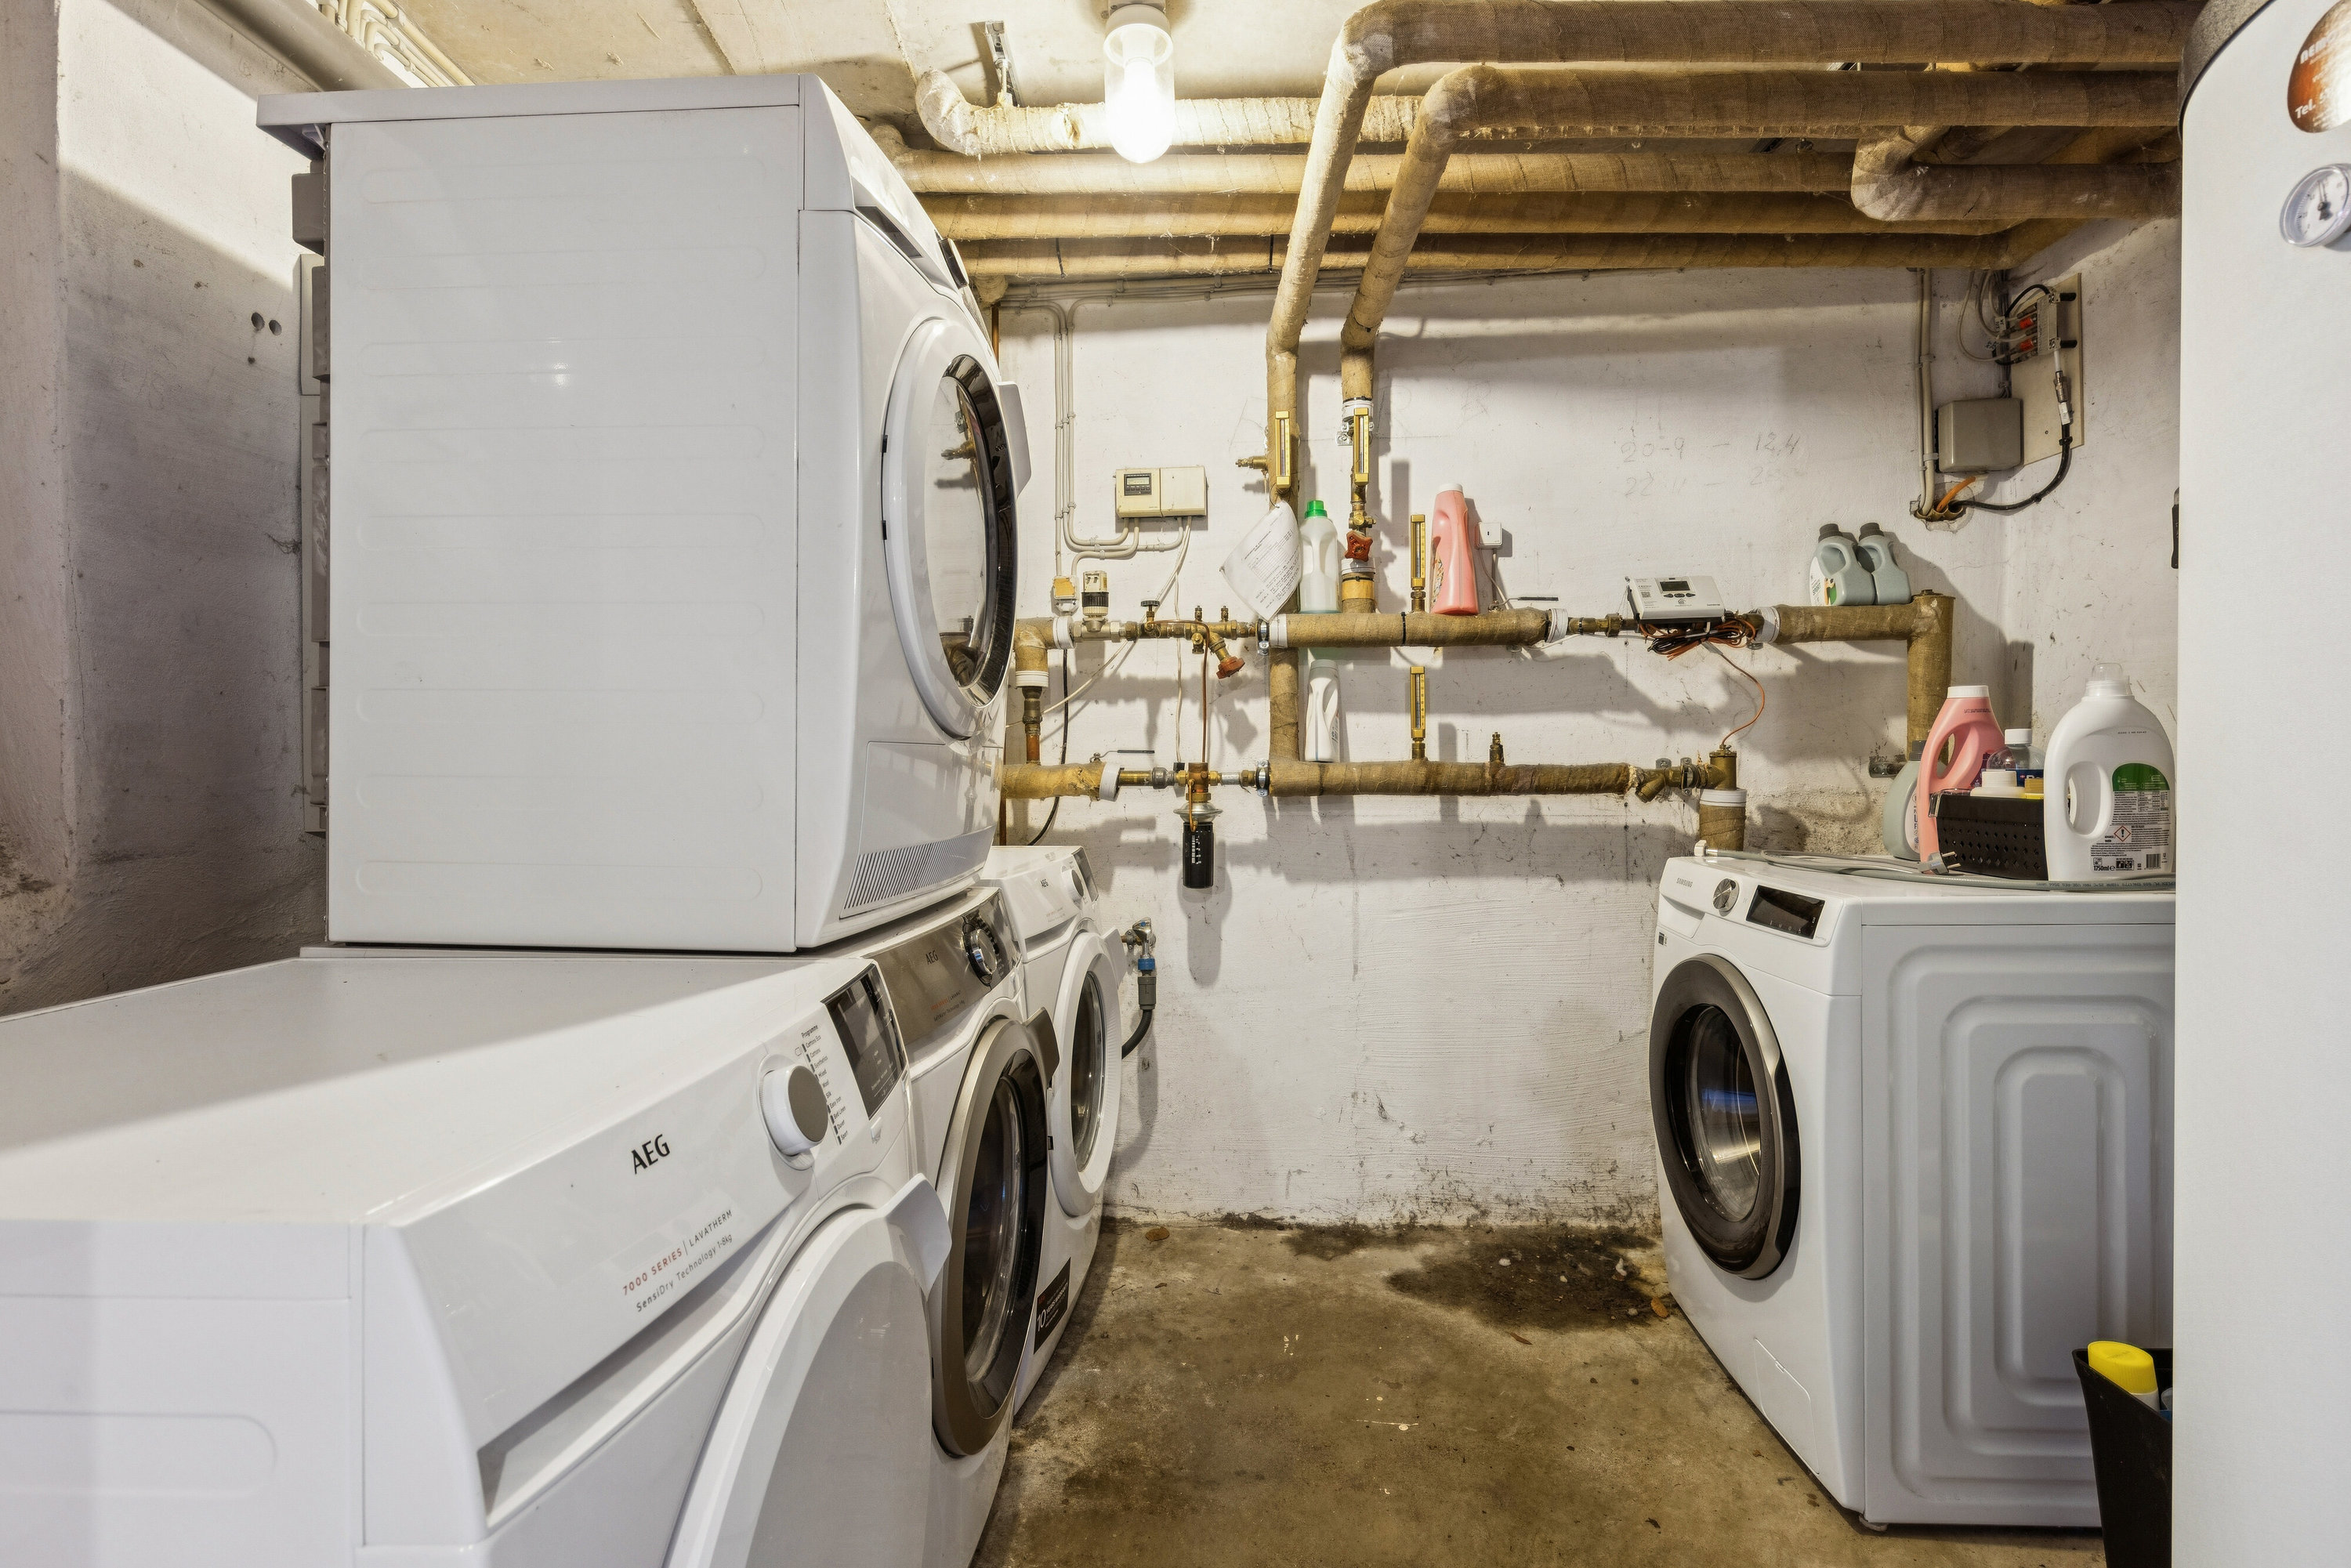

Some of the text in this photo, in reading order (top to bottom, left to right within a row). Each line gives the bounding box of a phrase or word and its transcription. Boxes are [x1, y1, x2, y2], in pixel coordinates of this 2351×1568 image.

[1040, 878, 1049, 888] AEG
[1676, 877, 1694, 888] SAMSUNG
[926, 950, 939, 965] AEG
[801, 1024, 819, 1038] Programme
[806, 1038, 816, 1048] Cottons
[813, 1056, 828, 1068] Synthetics
[818, 1069, 828, 1078] Mixed
[840, 1130, 849, 1140] Sport
[631, 1134, 671, 1175] AEG
[622, 1209, 733, 1295] 7000 SERIES LAVATHERM
[636, 1233, 733, 1313] SensiDry Technology 1-8kg
[1037, 1309, 1046, 1332] 10
